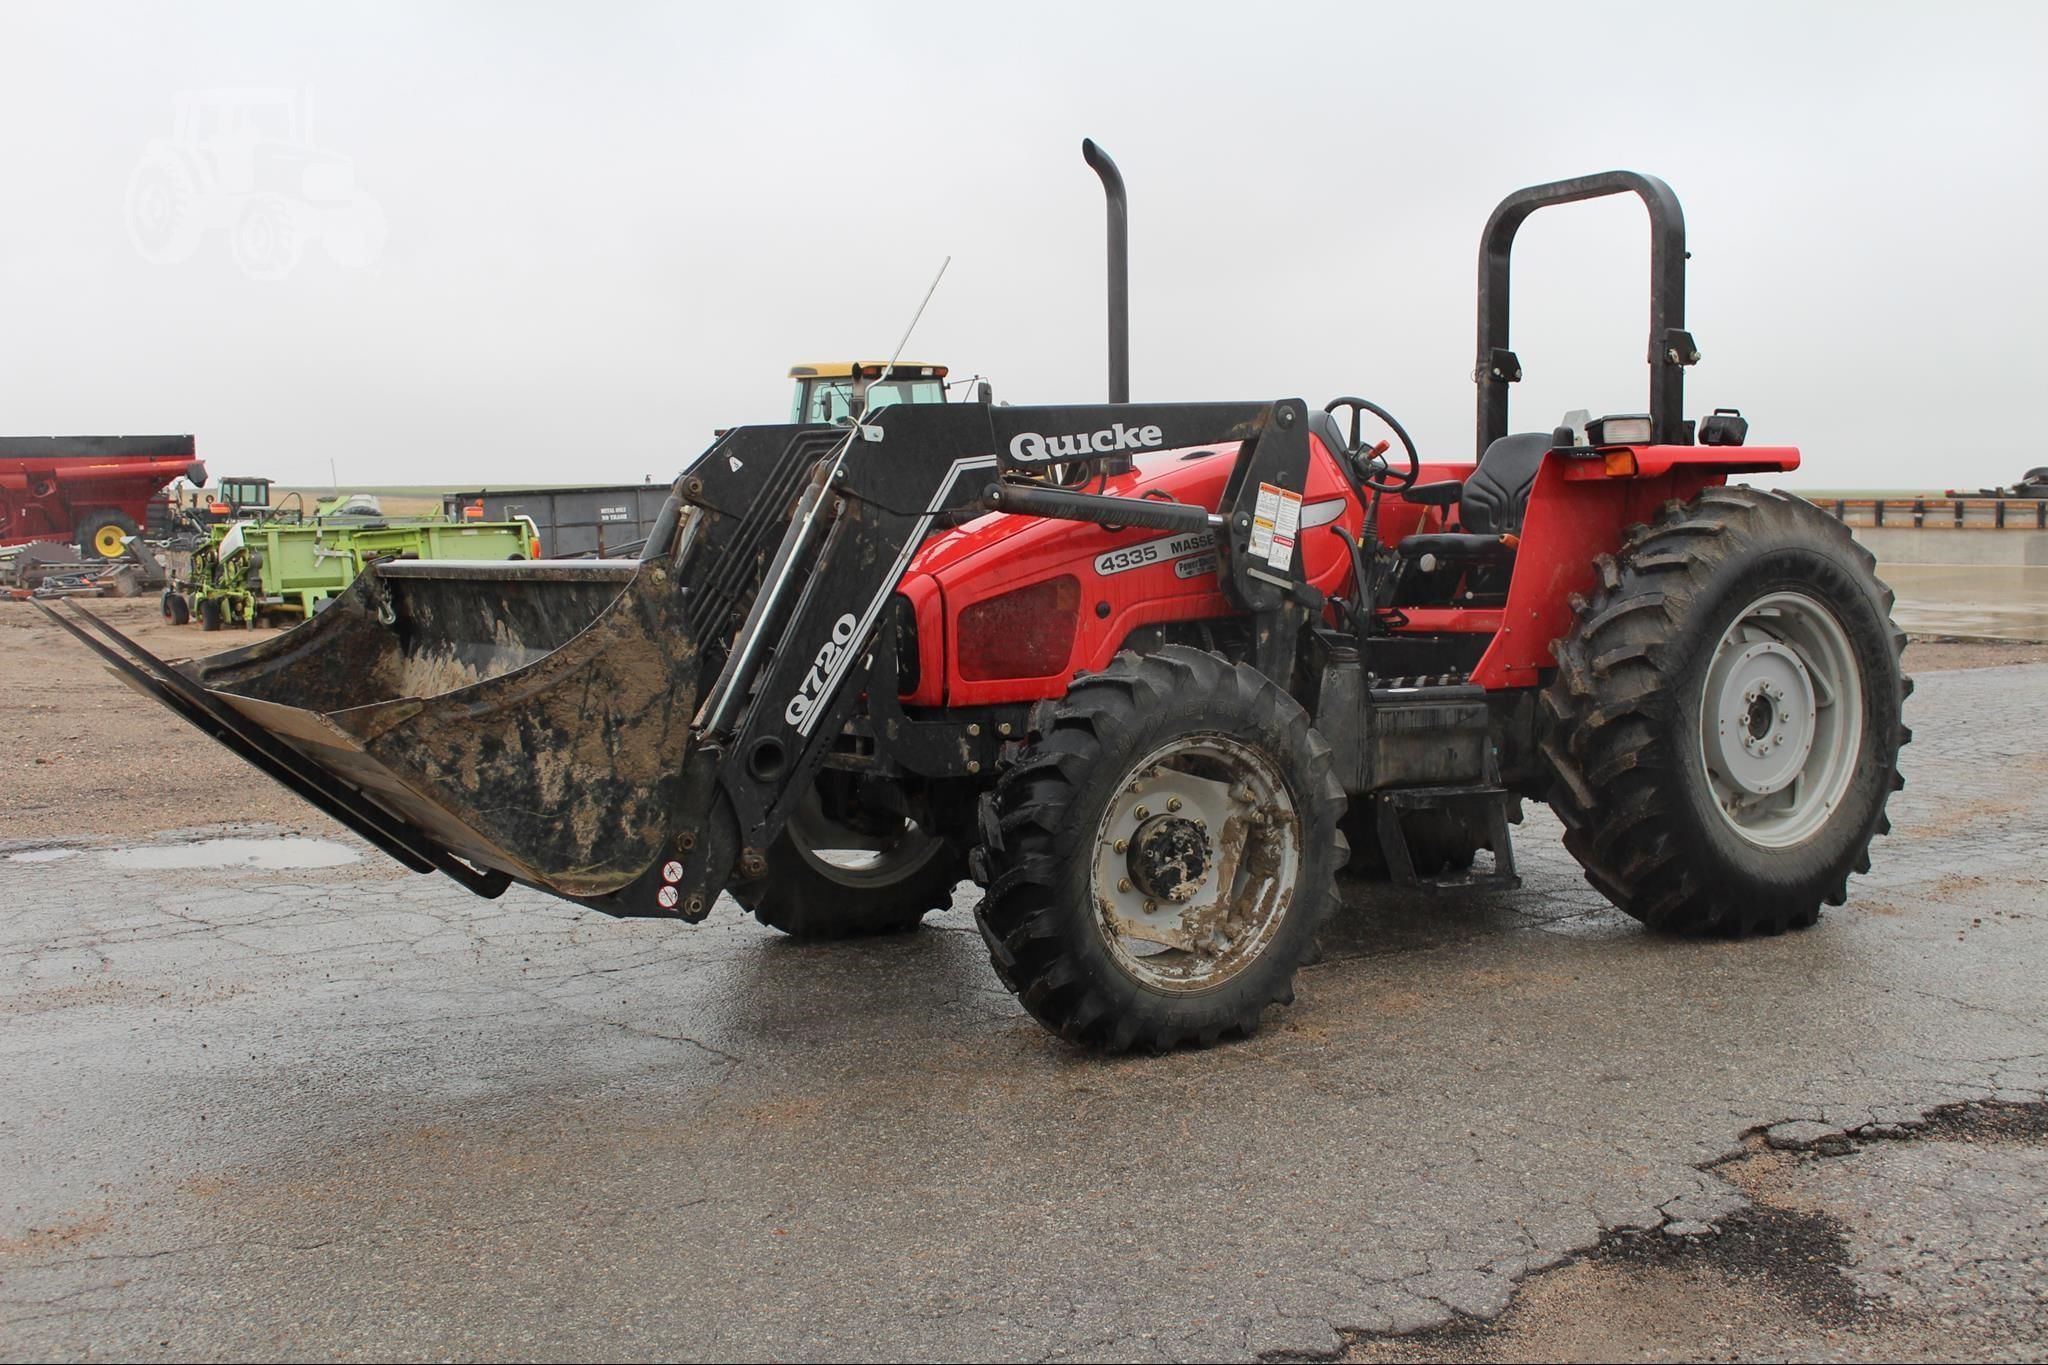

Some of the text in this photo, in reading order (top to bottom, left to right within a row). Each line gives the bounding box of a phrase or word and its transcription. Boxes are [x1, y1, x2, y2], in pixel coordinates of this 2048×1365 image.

[1009, 423, 1163, 462] Quicke
[1100, 545, 1158, 571] 4335
[784, 612, 857, 726] Q720
